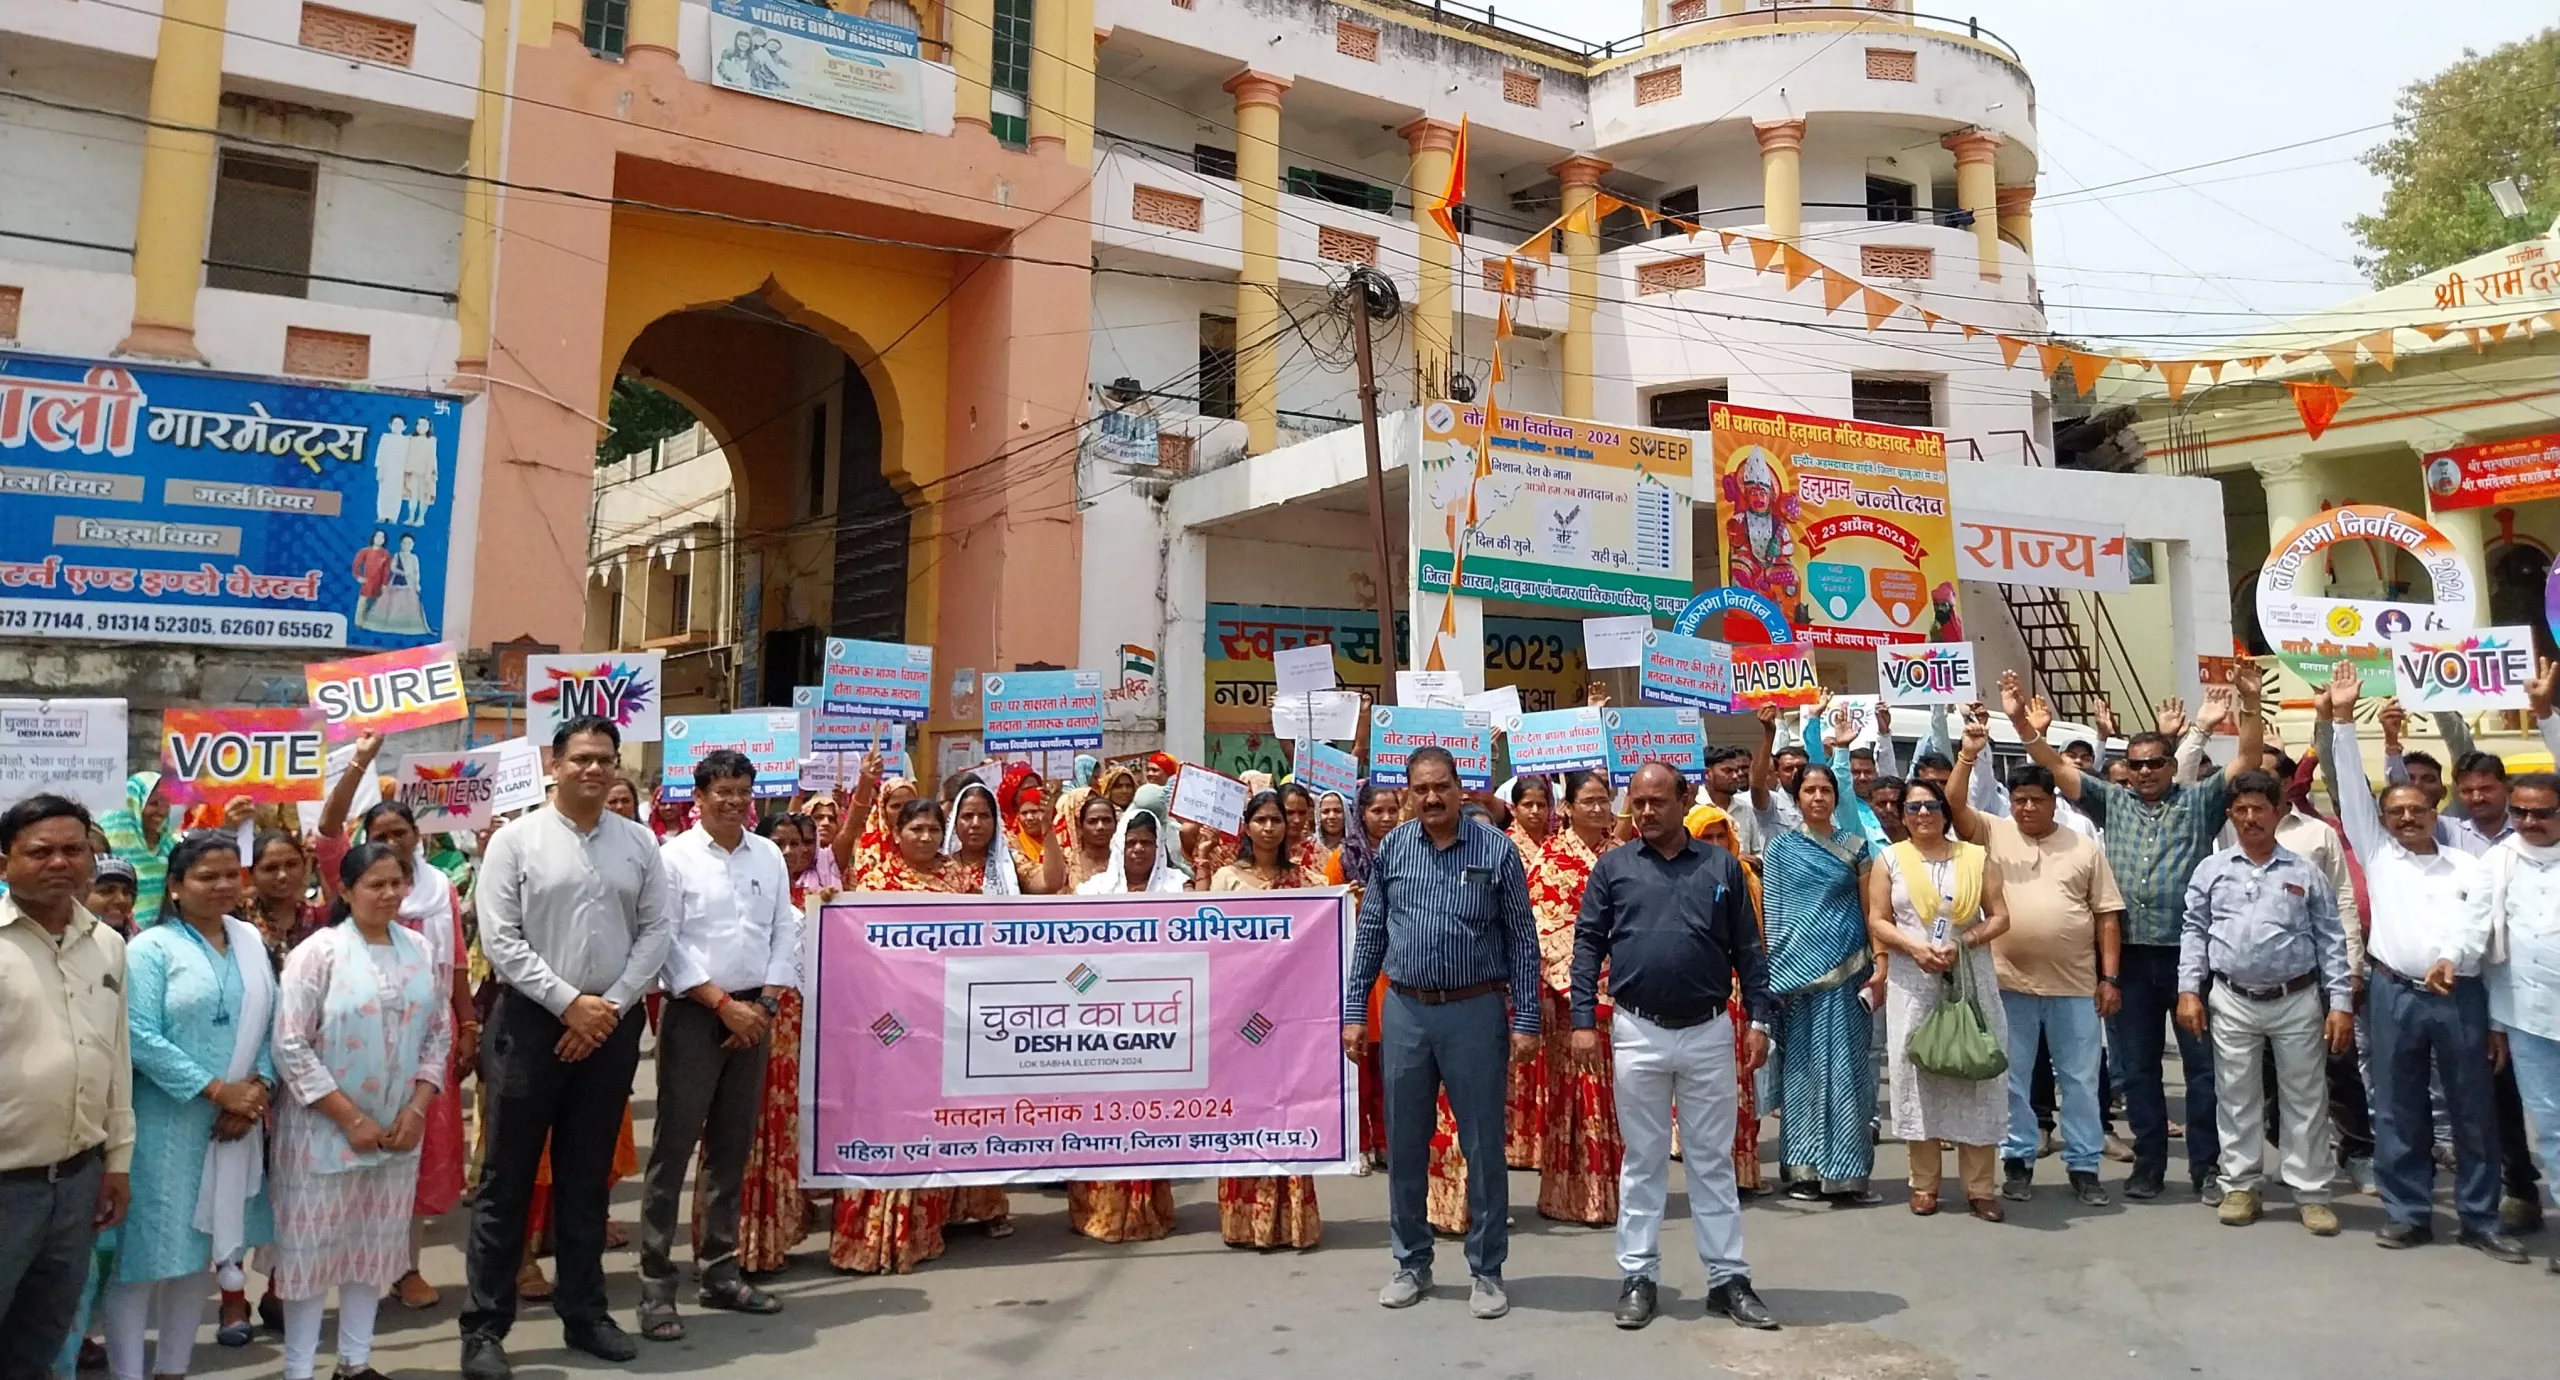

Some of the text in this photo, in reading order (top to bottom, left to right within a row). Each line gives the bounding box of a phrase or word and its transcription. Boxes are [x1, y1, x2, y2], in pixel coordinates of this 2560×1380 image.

[750, 6, 806, 31] VIJAYEE
[807, 19, 846, 41] BHAV
[849, 30, 915, 57] ACADEMY
[2434, 267, 2526, 312] श्री राम
[1523, 415, 1573, 440] निर्वाचन
[1588, 430, 1620, 448] 2024
[1712, 407, 1730, 432] श्री
[1732, 414, 1787, 438] चमत्कारी
[1788, 421, 1832, 448] हनुमान
[1834, 421, 1863, 447] मंदिर
[1914, 433, 1943, 458] छोटी
[1525, 461, 1541, 478] देश
[1542, 464, 1552, 479] के
[1553, 467, 1572, 482] नाम
[1525, 479, 1546, 494] आओ
[1547, 485, 1561, 497] हम
[1577, 486, 1614, 503] मतदान
[1799, 474, 1945, 517] हनुमान जन्मोत्सव
[1475, 530, 1511, 551] दिल की
[1821, 516, 1908, 548] 23 अप्रैल 2024
[1591, 546, 1610, 563] सही
[1961, 521, 2097, 578] राज्य
[2263, 509, 2465, 602] लोकसभा निर्वाचन 2024
[64, 562, 324, 601] एण्ड इण्डो वेस्टर्न
[1422, 566, 1451, 587] जिला
[1500, 575, 1537, 598] झाबुआ
[32, 610, 334, 640] 77144 91314 52305, 62607 65562
[1678, 588, 1772, 637] लोकसभा निर्वाचन
[1486, 632, 1565, 675] 2023
[1651, 651, 1674, 668] महिला
[1691, 655, 1702, 672] की
[2400, 648, 2528, 690] VOTE
[1882, 659, 1972, 689] VOTE
[317, 663, 458, 721] SURE
[560, 677, 629, 720] MY
[17, 729, 81, 739] DESH KA GARV
[988, 719, 1022, 733] मतदाता
[1383, 728, 1403, 746] वोट
[1470, 732, 1480, 752] है
[1641, 730, 1696, 748] हो या जवान
[170, 731, 321, 781] VOTE
[1478, 753, 1488, 772] है
[1620, 749, 1640, 765] सभी
[400, 774, 493, 807] MATTERS
[504, 777, 532, 794] GARV
[867, 906, 1293, 952] मतदाता जागरूकता अभियान
[979, 990, 1184, 1042] चुनाव का पर्व
[1014, 1031, 1178, 1054] DESH KA GARV
[1018, 1056, 1143, 1070] LOK SABHA ELECTION 2024
[934, 1097, 1235, 1129] मतदान दिनांक 13.05.2024
[836, 1134, 1054, 1163] महिला एवं बाल विकास
